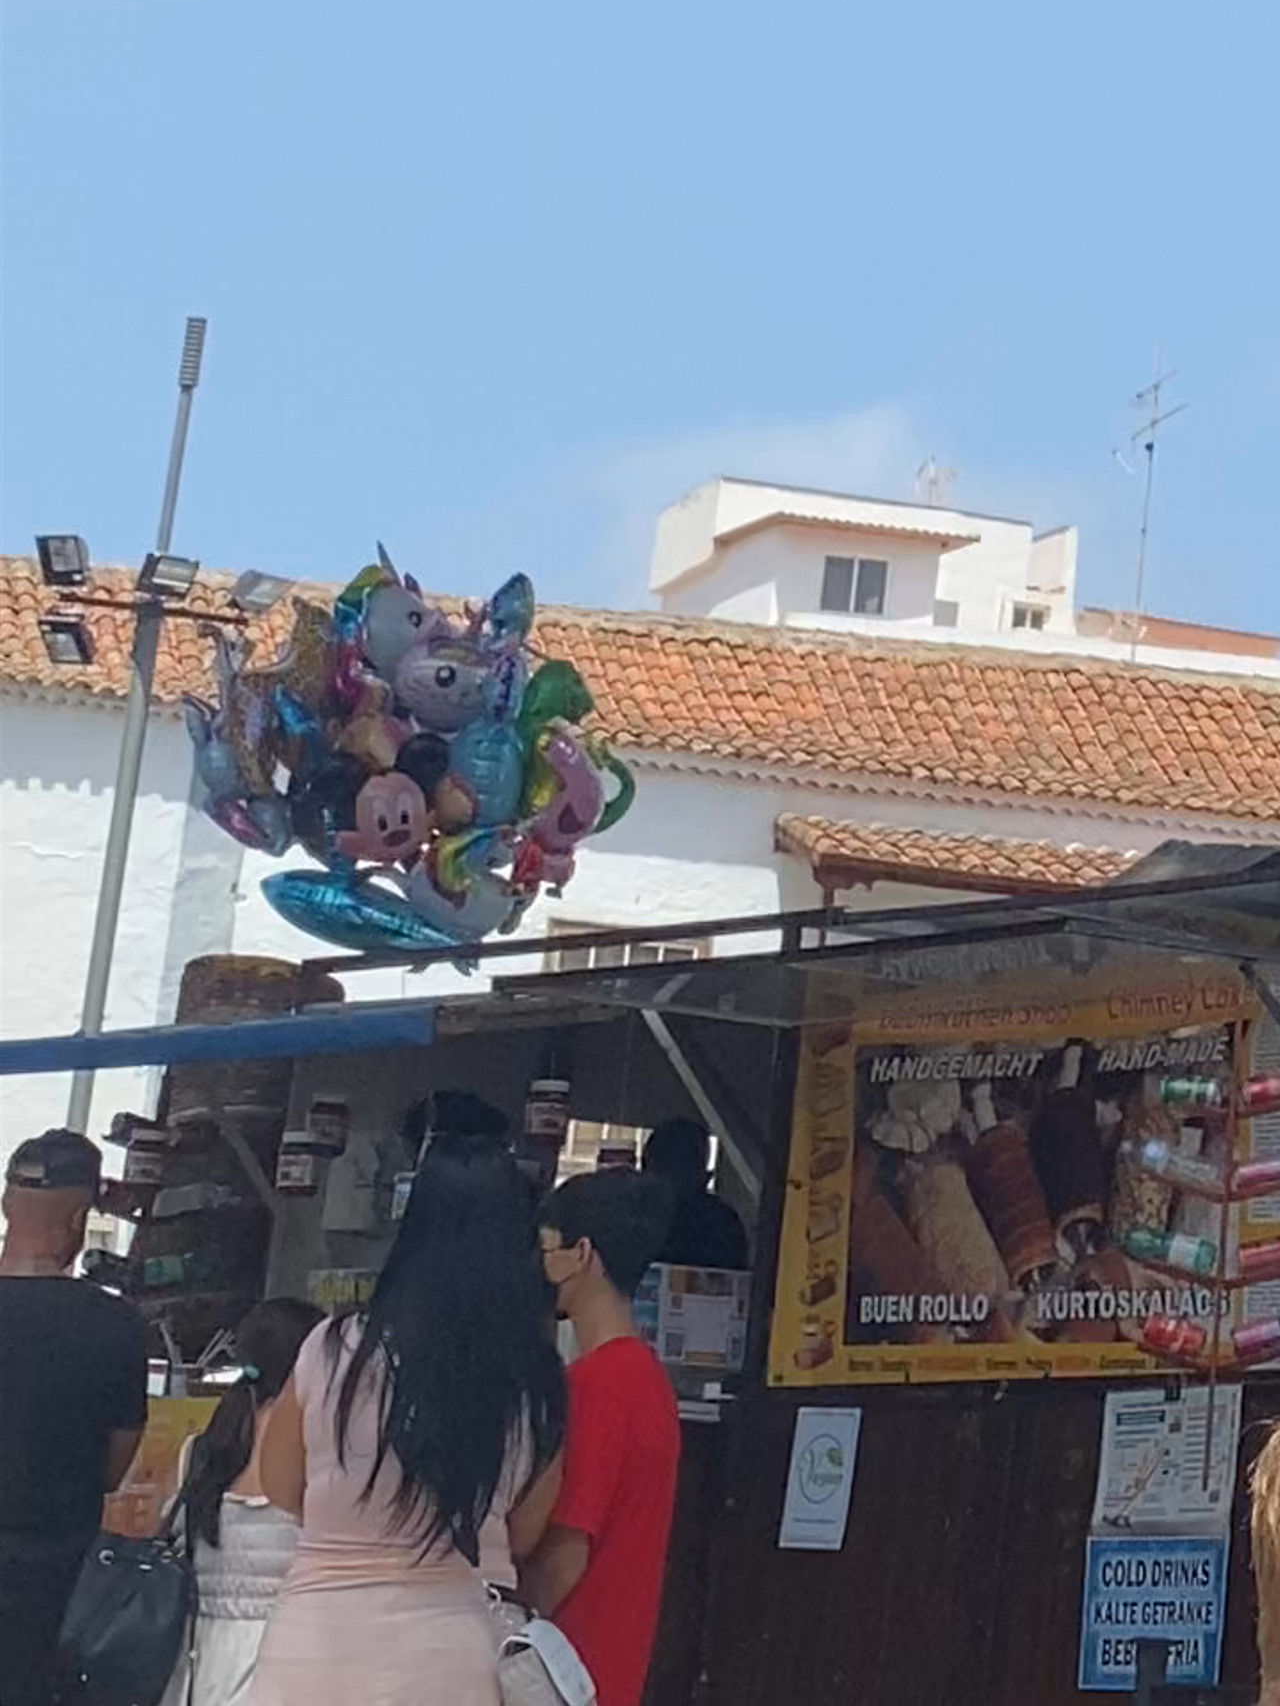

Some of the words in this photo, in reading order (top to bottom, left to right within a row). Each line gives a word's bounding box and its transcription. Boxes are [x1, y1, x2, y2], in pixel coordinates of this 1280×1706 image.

[870, 1052, 1044, 1084] HANDGEMACHT
[860, 1296, 914, 1323] BUEN
[919, 1294, 989, 1322] ROLLO
[1102, 1560, 1147, 1587] COLD
[1152, 1559, 1210, 1587] DRINKS
